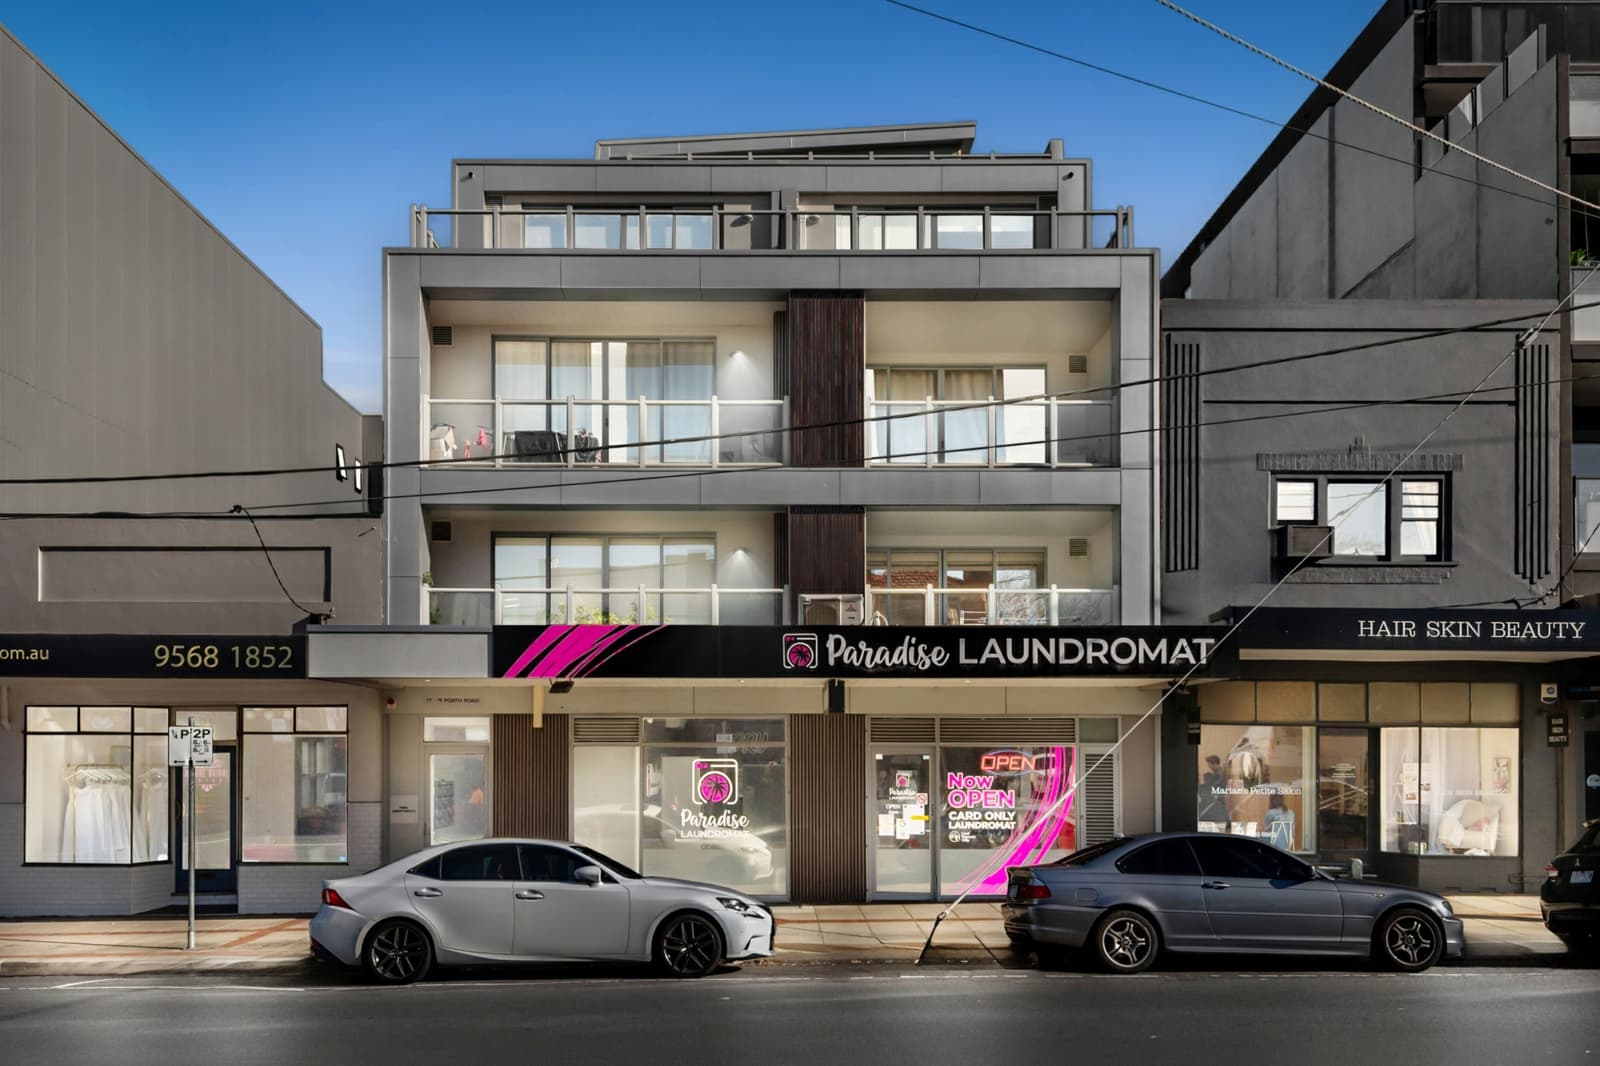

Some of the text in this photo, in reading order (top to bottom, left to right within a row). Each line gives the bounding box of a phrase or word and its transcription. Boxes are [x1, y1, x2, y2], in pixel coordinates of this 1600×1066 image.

[1357, 620, 1586, 639] HAIR SKIN BEAUTY
[154, 645, 293, 669] 9568 1852
[826, 633, 1215, 670] Paradise LAUNDROMAT
[193, 729, 211, 739] 2P
[981, 755, 1037, 771] OPEN
[947, 772, 994, 789] Now
[948, 789, 1016, 809] OPEN
[1250, 786, 1276, 795] Petite
[1277, 786, 1302, 795] Salon
[681, 808, 750, 829] Paradise
[948, 811, 1016, 821] CARD ONLY
[948, 821, 1017, 830] LAUNDROMAT
